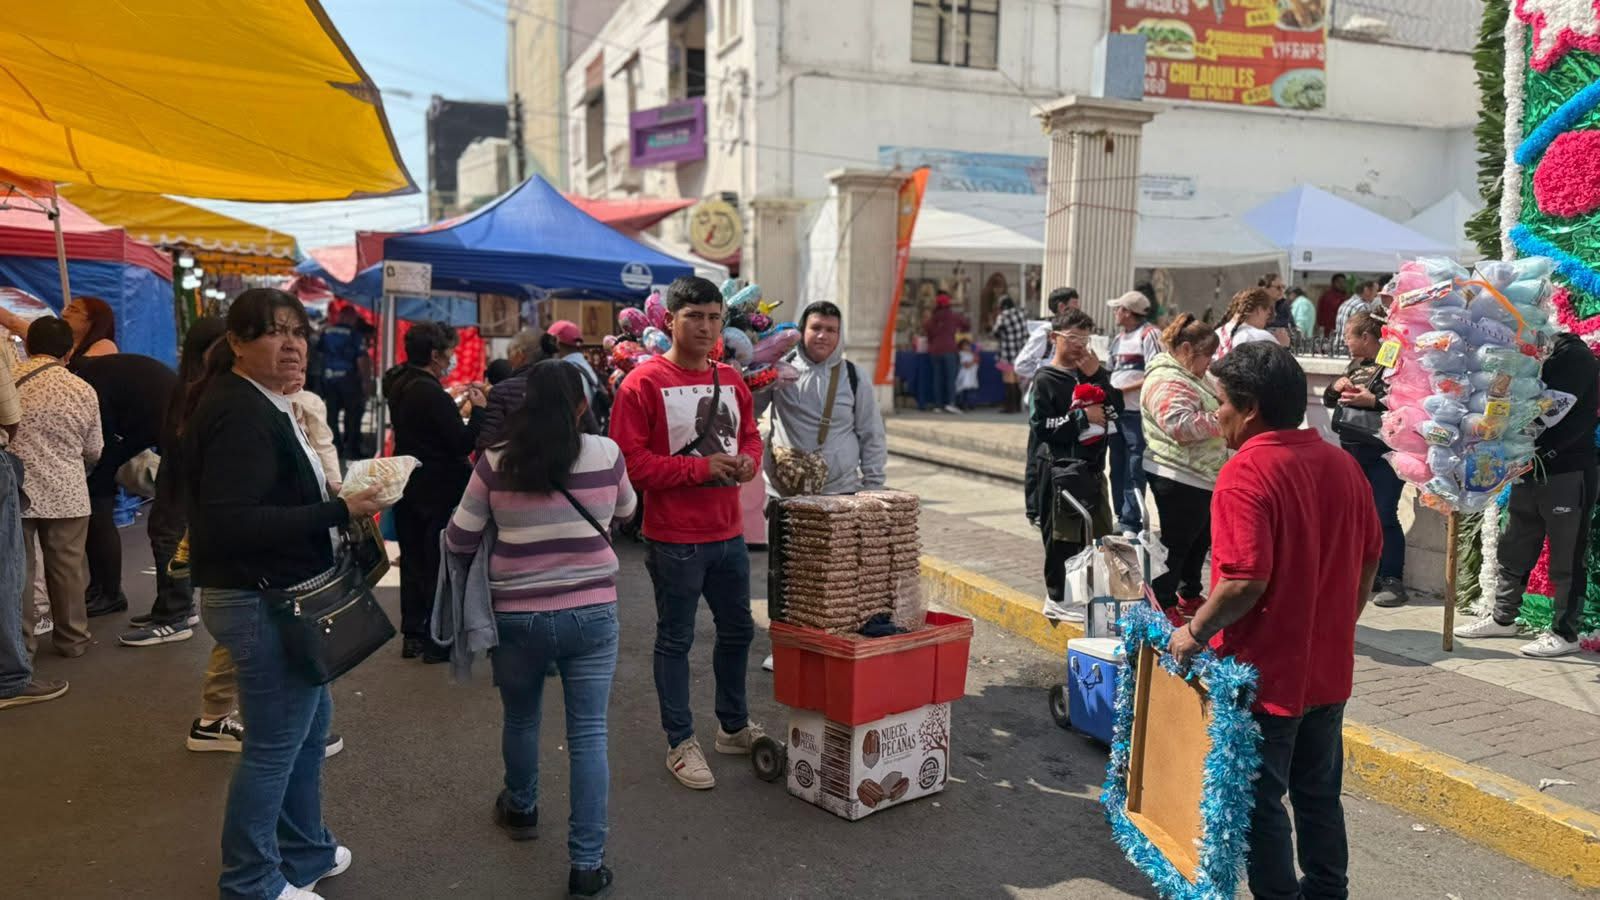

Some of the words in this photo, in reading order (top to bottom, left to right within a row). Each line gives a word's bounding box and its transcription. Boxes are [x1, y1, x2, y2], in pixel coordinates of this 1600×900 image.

[1169, 62, 1256, 88] CHILAQUILES
[881, 722, 908, 742] NUECES
[881, 734, 916, 758] PECANAS
